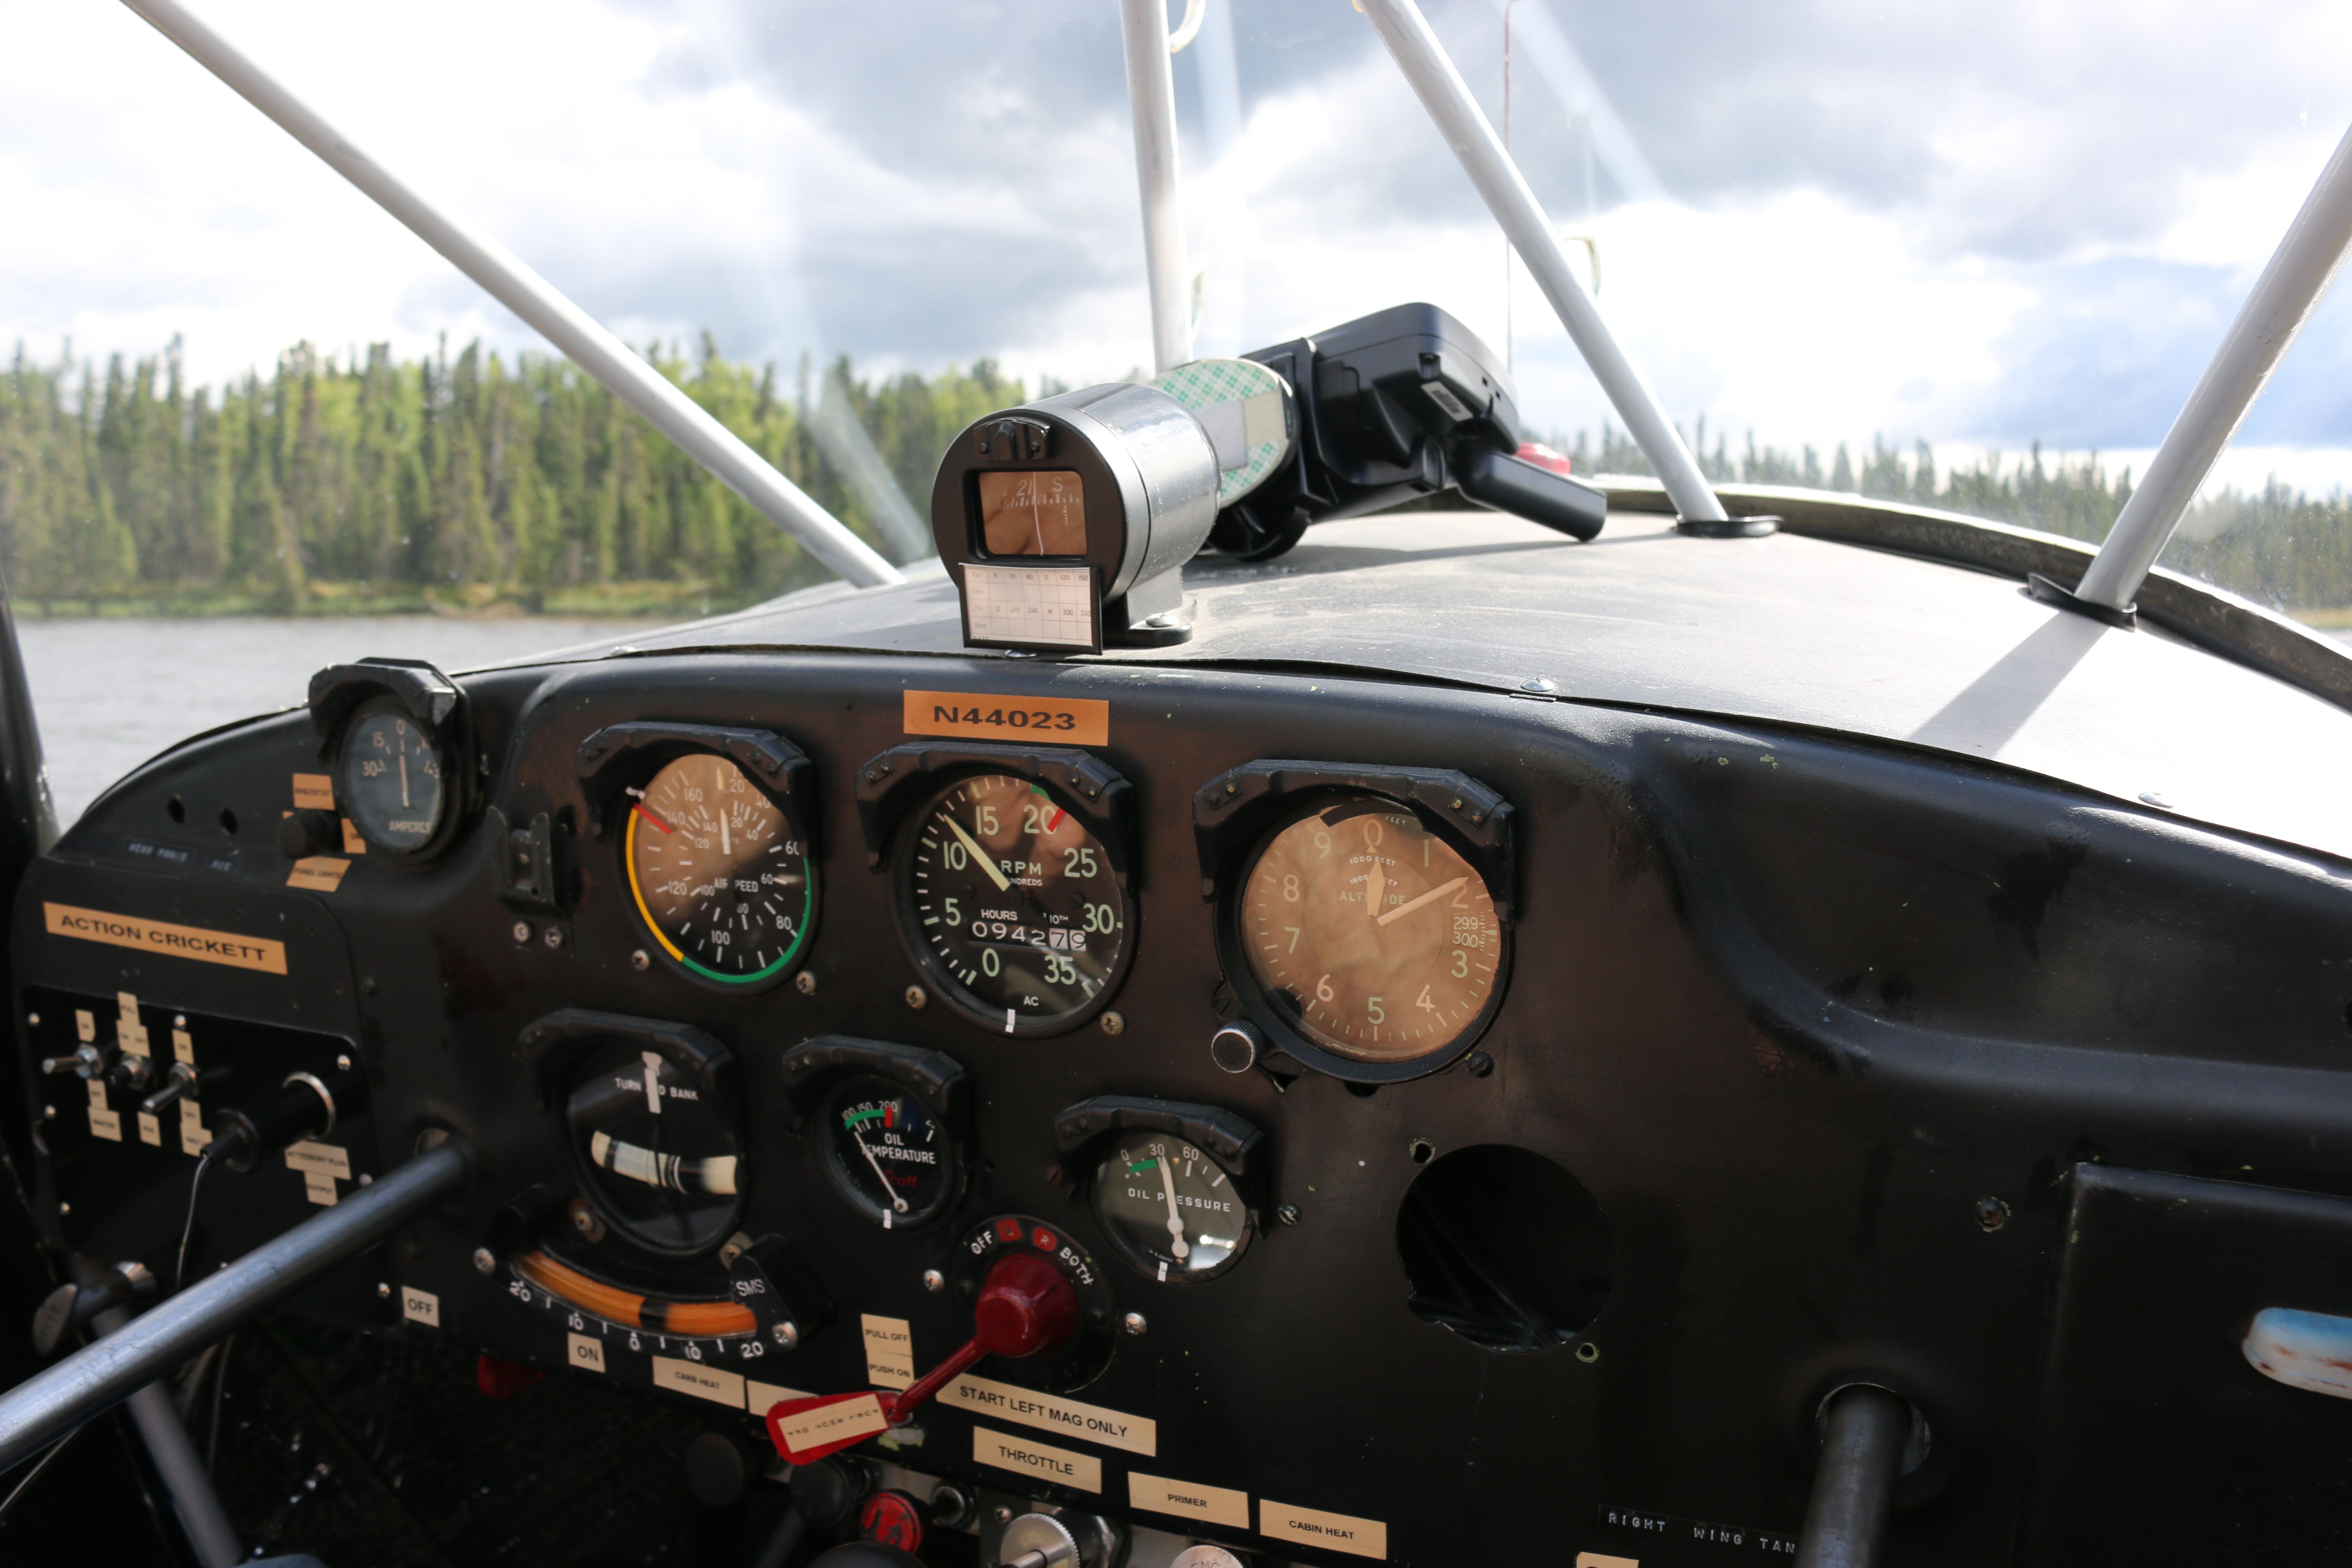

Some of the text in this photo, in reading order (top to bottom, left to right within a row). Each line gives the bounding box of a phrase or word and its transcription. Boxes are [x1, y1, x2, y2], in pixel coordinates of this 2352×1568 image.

[1053, 477, 1063, 492] S
[934, 705, 1076, 730] N44023
[396, 718, 406, 735] 0
[372, 732, 385, 747] 15
[362, 760, 378, 777] 30
[729, 779, 745, 793] 20
[684, 788, 703, 802] 160
[667, 811, 686, 825] 140
[732, 817, 743, 828] 20
[975, 805, 999, 836] 15
[1023, 804, 1058, 835] 20
[1385, 815, 1406, 826] FEET
[703, 821, 718, 833] 140
[746, 830, 759, 840] 40
[1363, 819, 1383, 846] 0
[694, 837, 709, 849] 120
[1314, 831, 1332, 859] 9
[943, 841, 967, 871] 10
[1064, 847, 1097, 878] 25
[1350, 855, 1372, 865] 1000
[1000, 860, 1042, 876] RPM
[760, 873, 773, 885] 60
[668, 880, 686, 896] 120
[701, 885, 715, 896] 100
[1283, 874, 1300, 903] 8
[1451, 883, 1469, 909] 2
[945, 897, 961, 926] 5
[981, 909, 1018, 921] HOURS
[1082, 903, 1115, 934] 30
[776, 915, 792, 930] 80
[1453, 916, 1479, 930] 29.9
[61, 915, 266, 961] ACTION CRICKETT
[711, 930, 730, 945] 100
[1283, 926, 1301, 954] 7
[982, 948, 1000, 977] 0
[1044, 955, 1076, 985] 35
[1451, 949, 1468, 979] 3
[1316, 974, 1334, 1002] 6
[1023, 995, 1039, 1007] AC
[1415, 984, 1436, 1013] 4
[1367, 997, 1385, 1025] 5
[614, 1077, 642, 1092] TURN
[669, 1086, 699, 1101] BANK
[857, 1102, 873, 1112] 150
[878, 1101, 898, 1112] 200
[884, 1133, 904, 1146] OIL
[1121, 1143, 1199, 1161] 0 30 60
[1128, 1188, 1231, 1213] OIL PESSURE
[971, 1231, 993, 1255] OFF
[1040, 1234, 1050, 1246] R
[1059, 1246, 1094, 1284] BOTH
[509, 1280, 531, 1302] 20
[407, 1298, 433, 1315] OFF
[568, 1314, 584, 1331] 10
[629, 1337, 640, 1351] 0
[865, 1329, 908, 1342] PULL OFF
[577, 1345, 599, 1362] ON
[684, 1345, 701, 1360] 10
[740, 1341, 764, 1358] 20
[869, 1363, 910, 1378] PUSH ON
[674, 1372, 720, 1390] CARB HEAT
[960, 1385, 1127, 1437] START LEFT MAG ONLY
[998, 1446, 1074, 1476] THROTTLE
[1167, 1493, 1207, 1508] PRIMER
[1289, 1520, 1355, 1540] CABIN HEAT
[1608, 1512, 1795, 1554] RIGHT WING TAN
